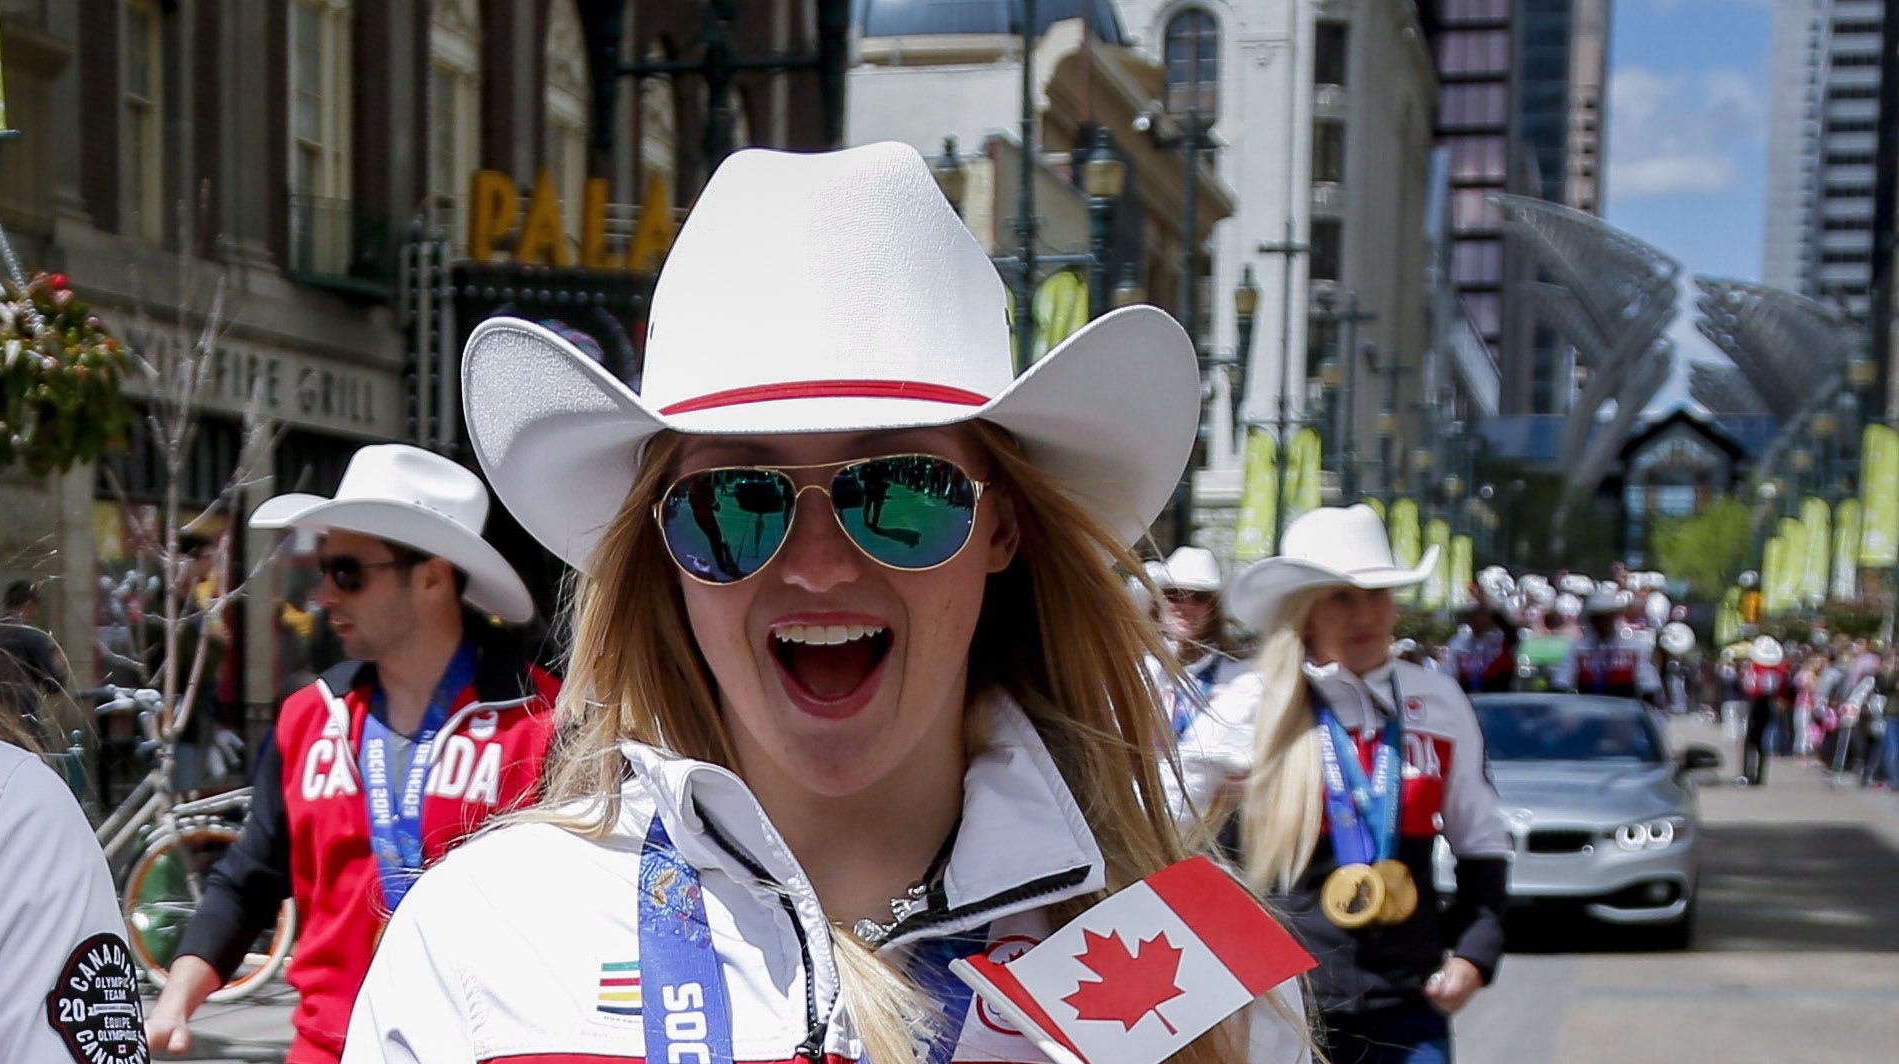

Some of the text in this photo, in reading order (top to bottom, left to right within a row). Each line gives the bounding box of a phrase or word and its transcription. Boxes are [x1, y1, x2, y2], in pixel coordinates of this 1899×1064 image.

[468, 168, 676, 271] PALA
[301, 734, 503, 806] CADA
[367, 738, 387, 786] SOCHI
[58, 998, 86, 1022] 20
[104, 989, 127, 1001] TEAM
